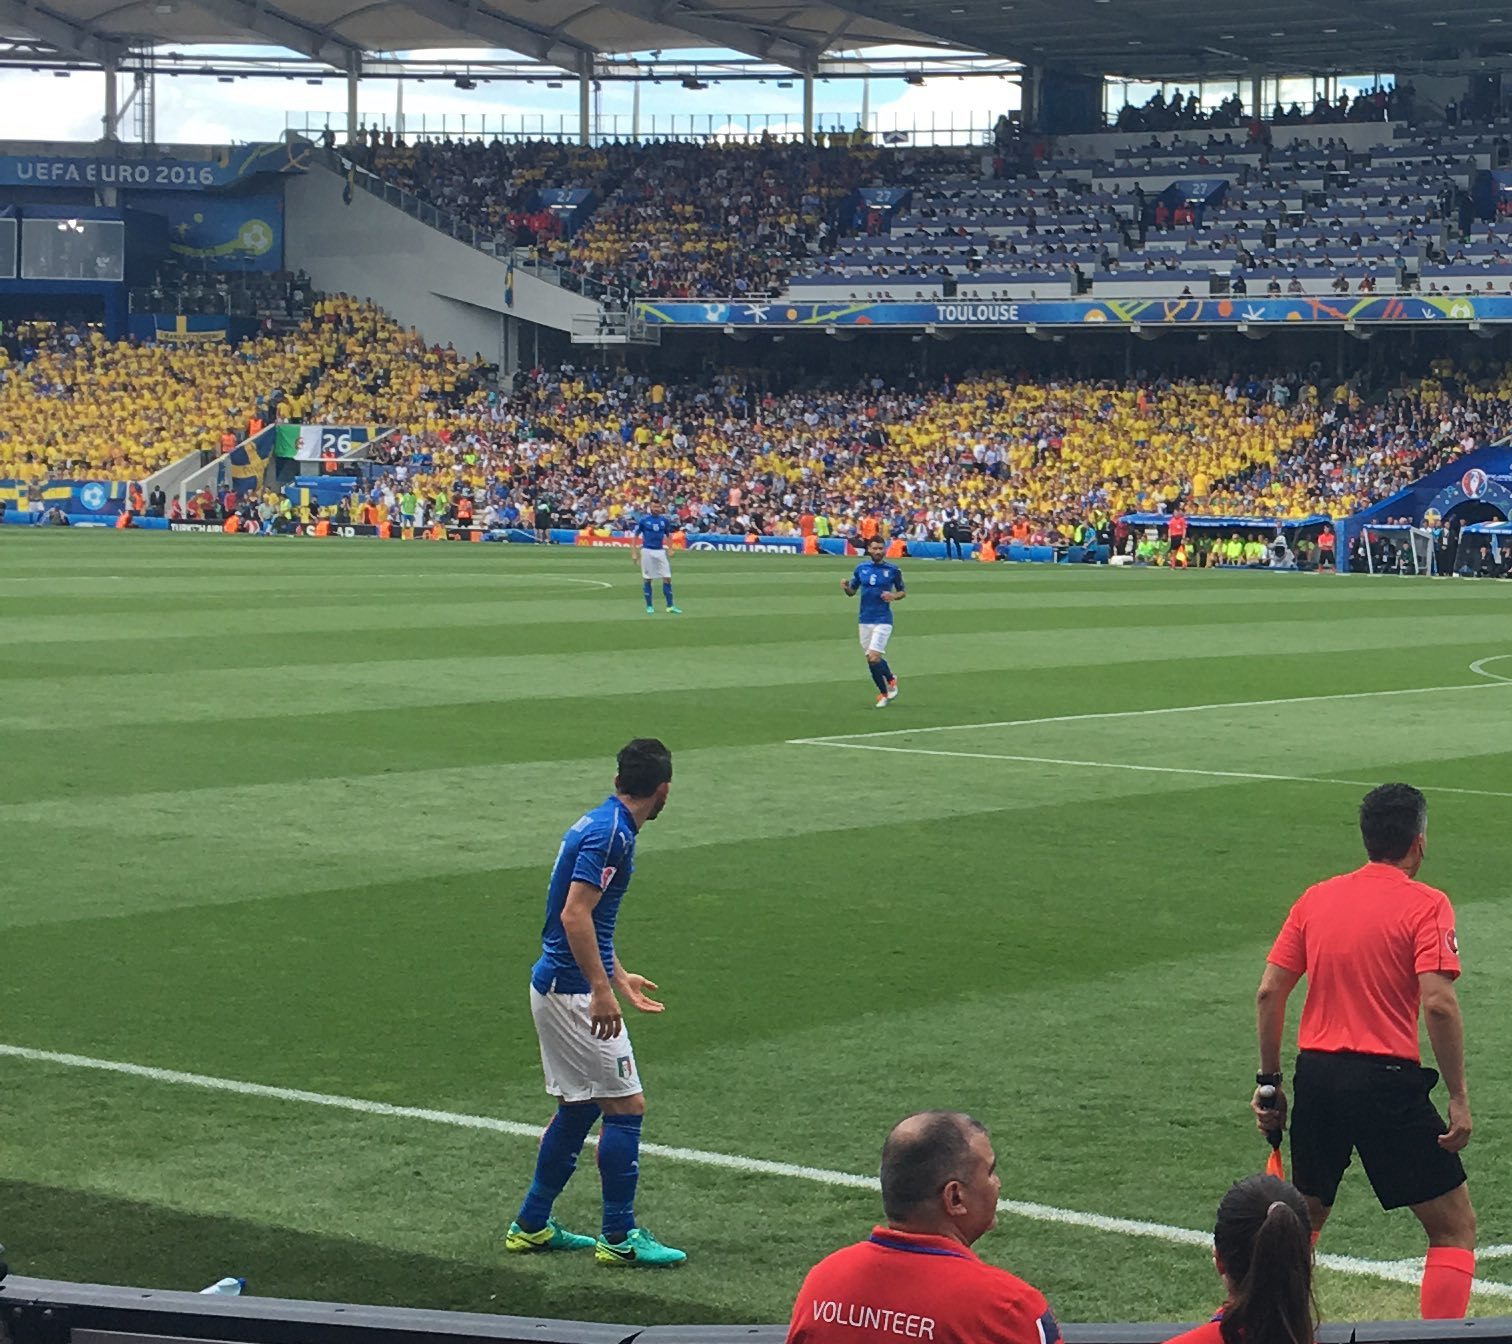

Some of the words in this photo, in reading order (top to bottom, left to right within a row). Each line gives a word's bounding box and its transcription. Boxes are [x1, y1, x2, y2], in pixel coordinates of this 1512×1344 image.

[17, 162, 80, 182] UEFA
[86, 164, 150, 183] EURO
[155, 166, 214, 185] 2016
[875, 190, 892, 202] 27
[1191, 182, 1208, 195] 27
[937, 305, 1019, 321] TOULOUSE
[322, 433, 352, 454] 26
[813, 1299, 935, 1341] VOLUNTEER
